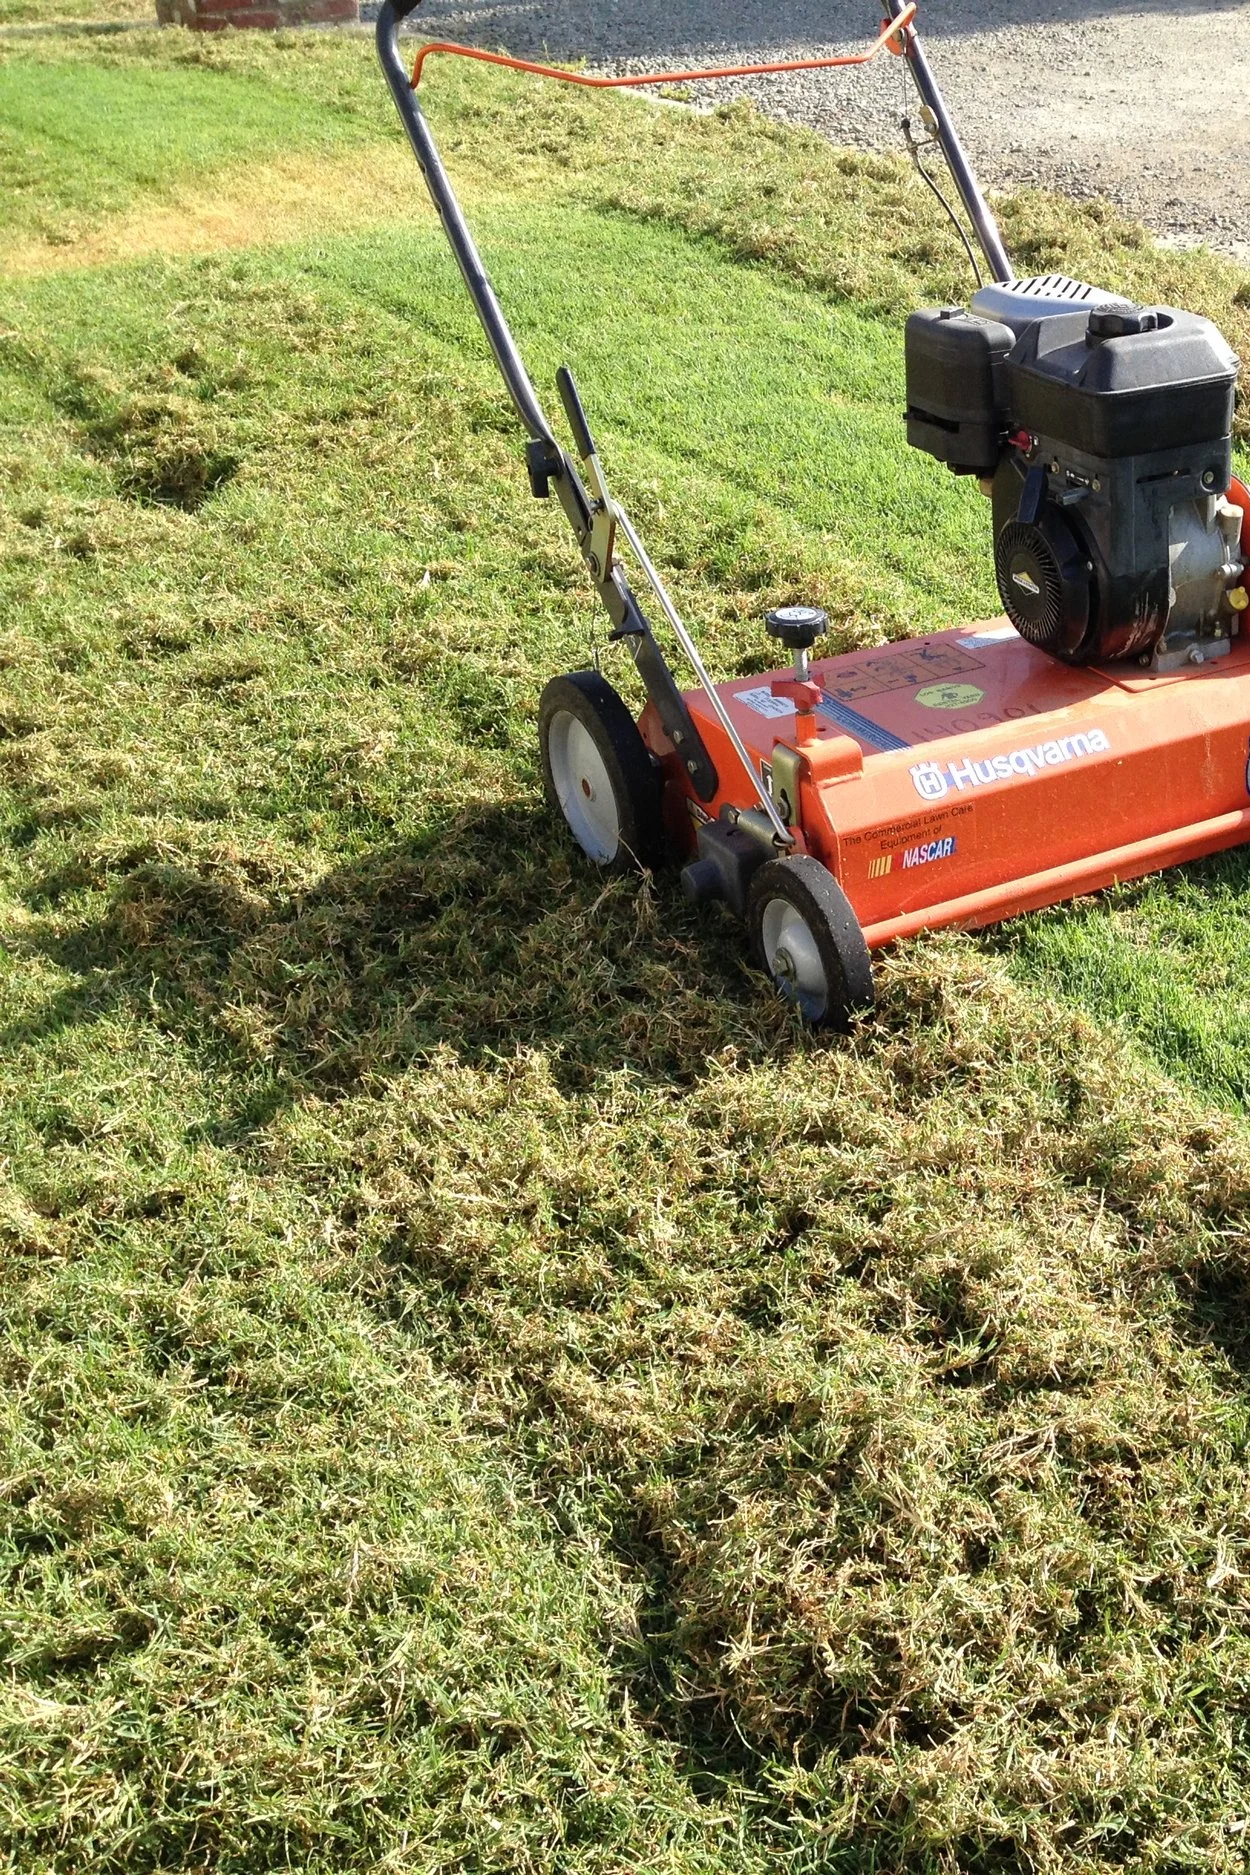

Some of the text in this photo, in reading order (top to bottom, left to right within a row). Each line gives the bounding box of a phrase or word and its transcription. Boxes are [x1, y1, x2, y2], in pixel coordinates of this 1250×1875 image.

[947, 728, 1112, 791] Husqvarna
[843, 803, 974, 847] The Commercial Lawn Care
[880, 825, 943, 851] Equipment of
[902, 836, 954, 870] NASCAR
